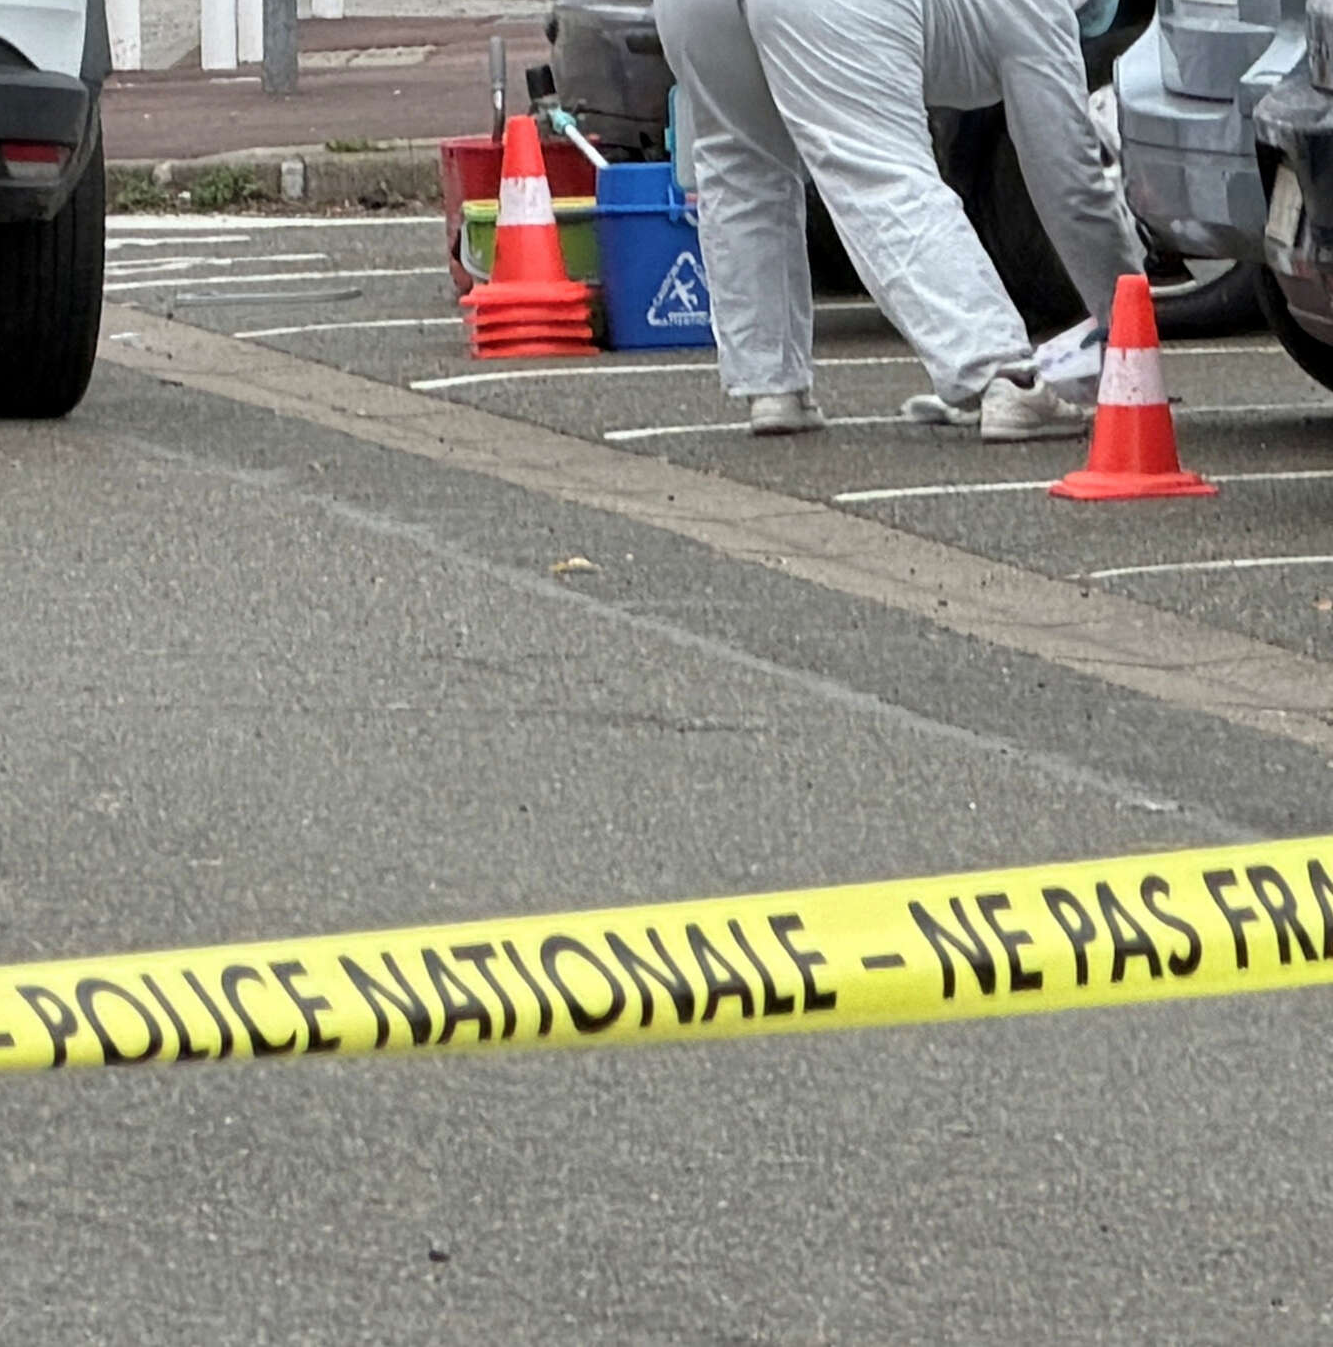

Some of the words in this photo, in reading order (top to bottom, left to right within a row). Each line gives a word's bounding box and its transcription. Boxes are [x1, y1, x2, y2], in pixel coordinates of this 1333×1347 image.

[16, 959, 342, 1068] POLICE
[336, 913, 837, 1051] NATIONALE
[907, 891, 1044, 1001] NE
[1041, 874, 1203, 987] PAS
